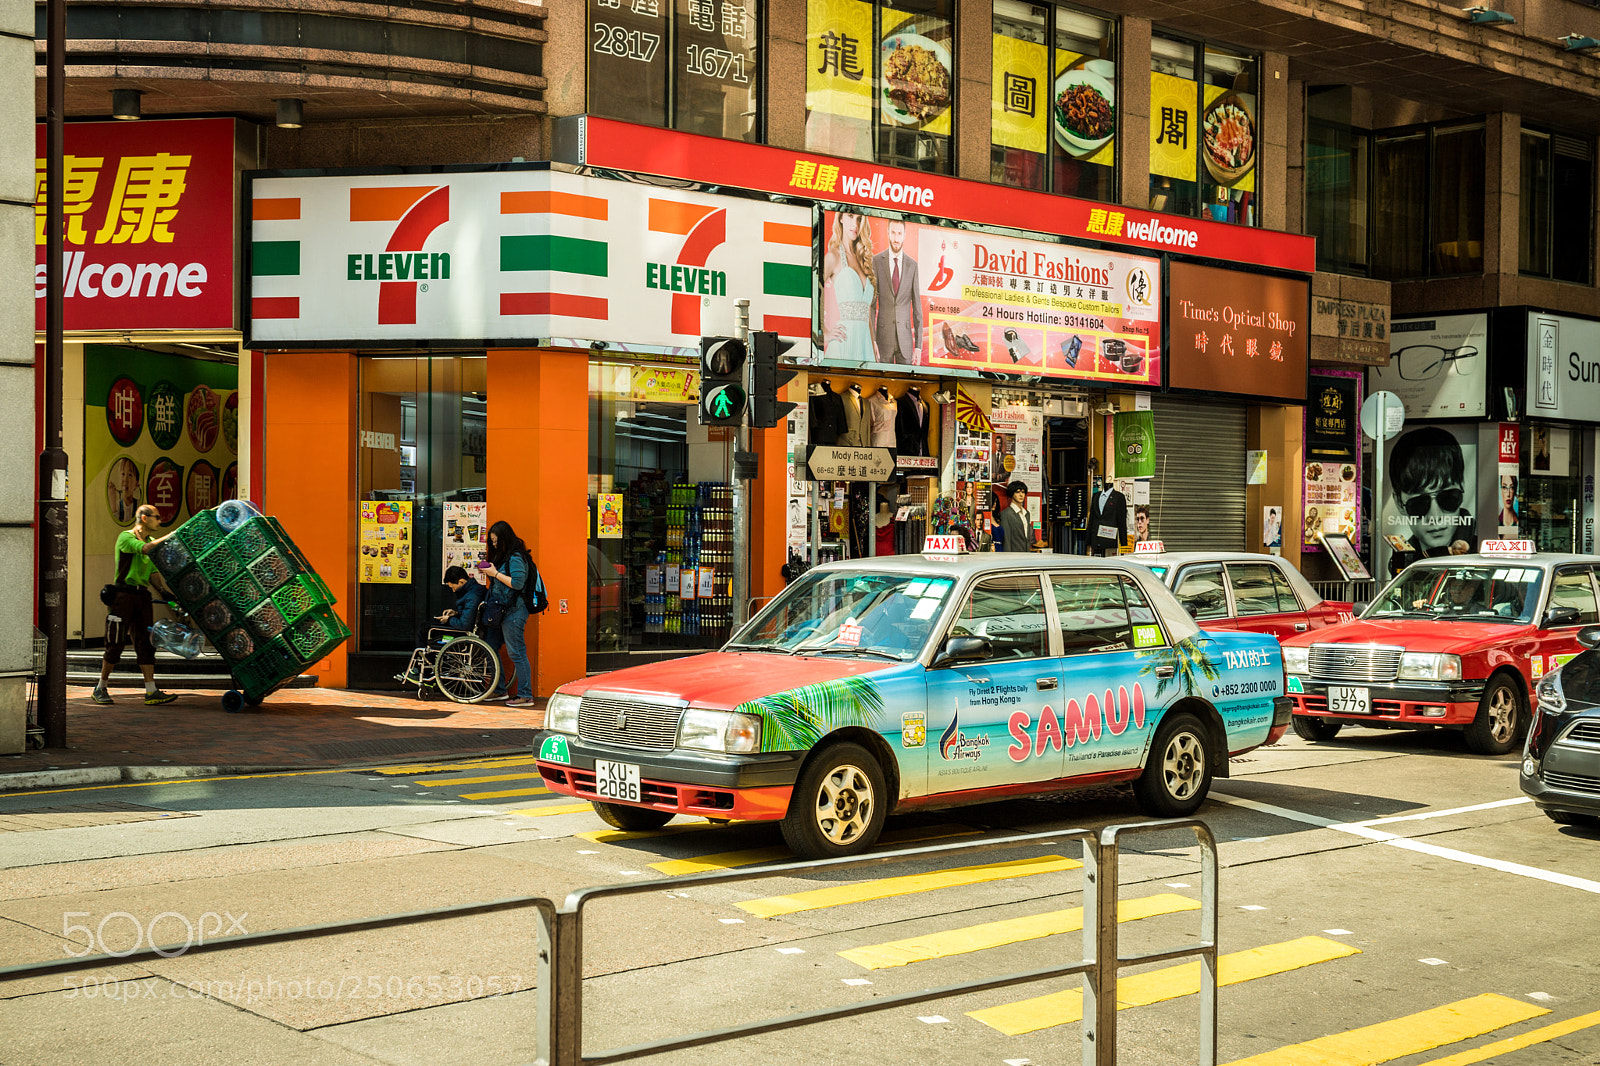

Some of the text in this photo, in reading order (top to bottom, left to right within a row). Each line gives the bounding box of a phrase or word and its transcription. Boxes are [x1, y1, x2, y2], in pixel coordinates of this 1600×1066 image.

[594, 22, 749, 84] 2817 1671
[816, 29, 865, 82] 龍
[1155, 105, 1189, 151] 閣
[789, 160, 935, 208] 惠康 wellcome
[1086, 208, 1198, 248] 惠康 wellcome
[972, 244, 1109, 286] David Fashions
[929, 304, 946, 313] Since
[964, 287, 1004, 301] Professional
[1004, 293, 1024, 303] Ladies
[1052, 298, 1077, 310] Bespoke
[1077, 301, 1100, 312] Custom
[1101, 304, 1120, 314] Tailors
[982, 305, 1105, 330] 24 Hours Hotline: 93141604
[1179, 299, 1296, 338] Time's Optical Shop
[1316, 300, 1386, 322] EMPRESS PLAZA
[1194, 330, 1284, 362] 時代眼鏡
[1541, 329, 1553, 401] 金時代
[155, 394, 175, 433] 鮮
[831, 450, 873, 461] Mody Road
[1501, 441, 1517, 454] REY
[154, 473, 174, 507] 至
[1387, 514, 1474, 526] SAINT LAURENT
[926, 537, 955, 550] TAXI
[1585, 517, 1594, 553] Sunrise
[1137, 542, 1157, 551] TAXI
[1485, 541, 1528, 551] TAXI
[1222, 650, 1250, 670] TAXI
[990, 686, 995, 694] 2
[995, 685, 1017, 695] Flights
[1220, 684, 1239, 696] +852
[1240, 681, 1258, 693] 2300
[1259, 680, 1277, 691] 0000
[1340, 687, 1357, 700] UX
[981, 696, 999, 706] Hong
[999, 695, 1016, 705] Kong
[1332, 698, 1367, 712] 5779
[1007, 681, 1146, 763] SAMUI
[1227, 716, 1269, 728] bangkokair.com
[551, 741, 558, 753] 5
[959, 730, 990, 749] Bangkok
[952, 744, 981, 762] Airways
[1096, 750, 1121, 759] Paradise
[608, 761, 627, 782] KU
[599, 778, 637, 800] 2086
